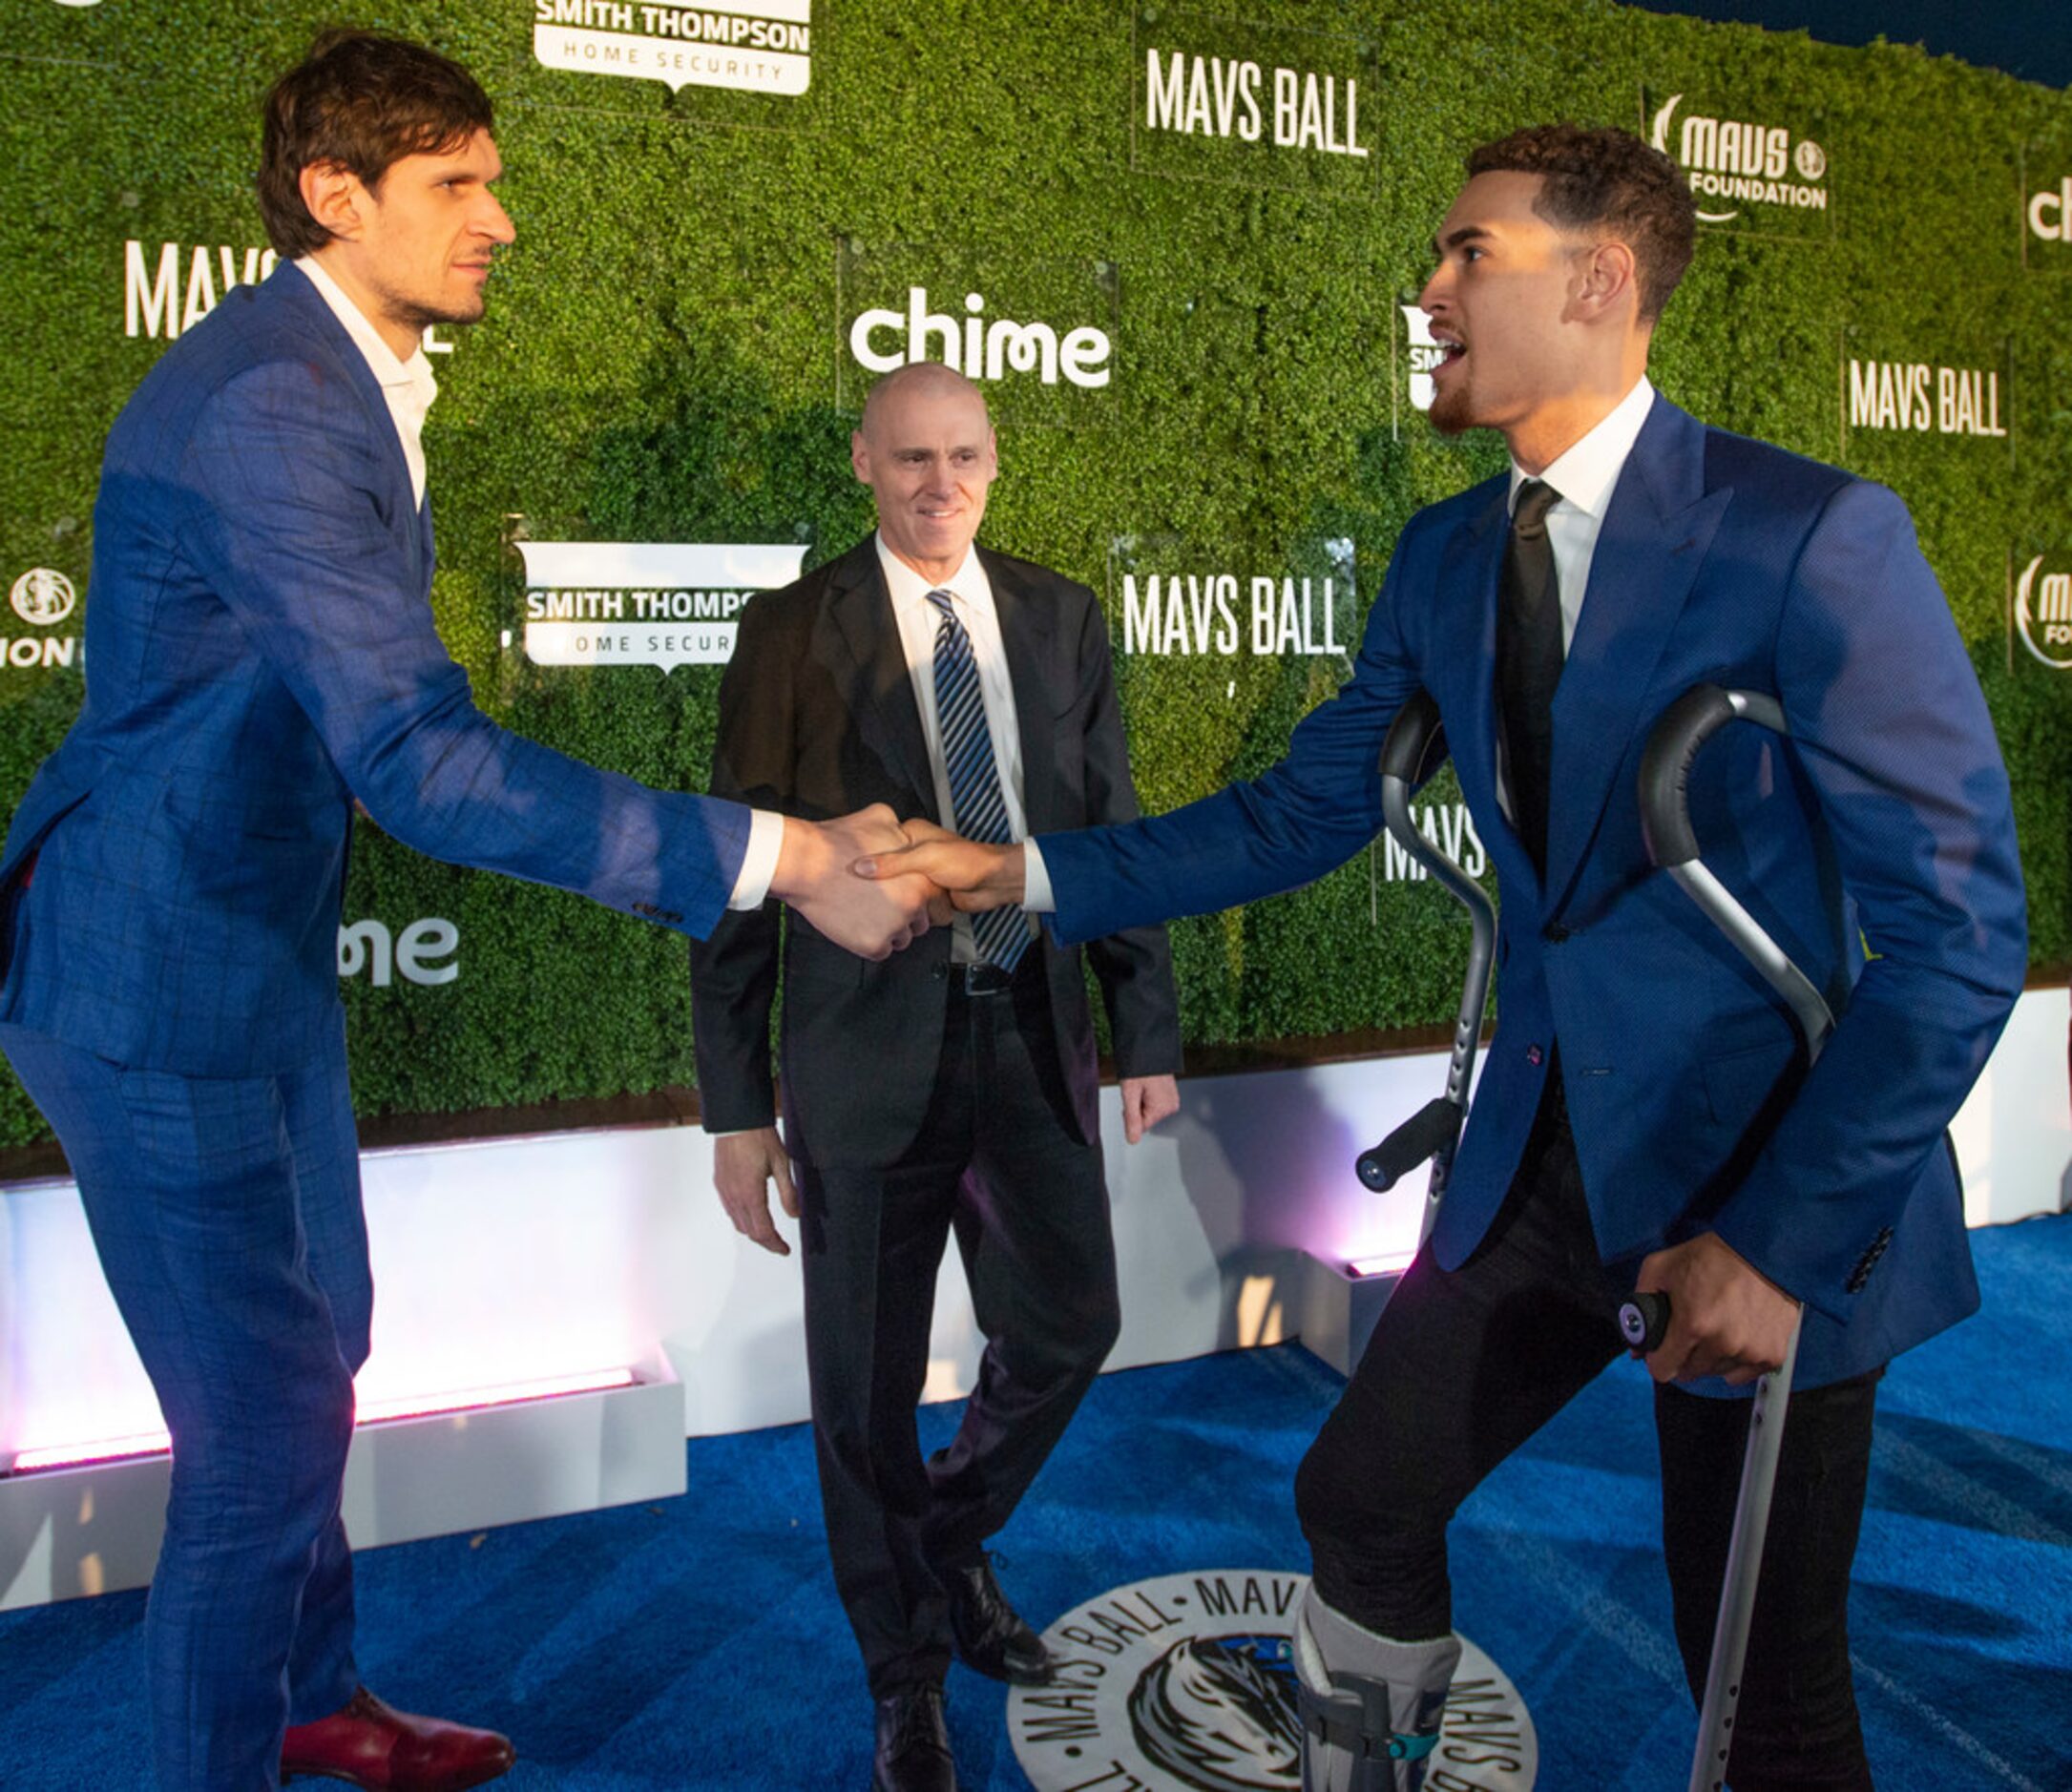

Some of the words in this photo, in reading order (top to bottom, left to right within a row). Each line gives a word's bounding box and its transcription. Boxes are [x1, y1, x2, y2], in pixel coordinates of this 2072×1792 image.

[535, 0, 634, 30] SMITH
[640, 6, 810, 52] THOMPSON
[564, 41, 639, 64] HOME
[656, 51, 783, 80] SECURITY
[1147, 48, 1262, 141] MAVS
[1274, 67, 1369, 157] BALL
[1689, 172, 1827, 210] FOUNDATION
[125, 240, 278, 340] MA
[849, 286, 1111, 388] chime
[1850, 359, 1932, 432] MAVS
[1938, 366, 2006, 436] BALL
[527, 592, 622, 619] SMITH
[1123, 574, 1239, 656] MAVS
[1251, 576, 1346, 656] BALL
[576, 636, 630, 652] OME
[648, 636, 729, 651] SECUR
[1061, 1591, 1183, 1656] BALL
